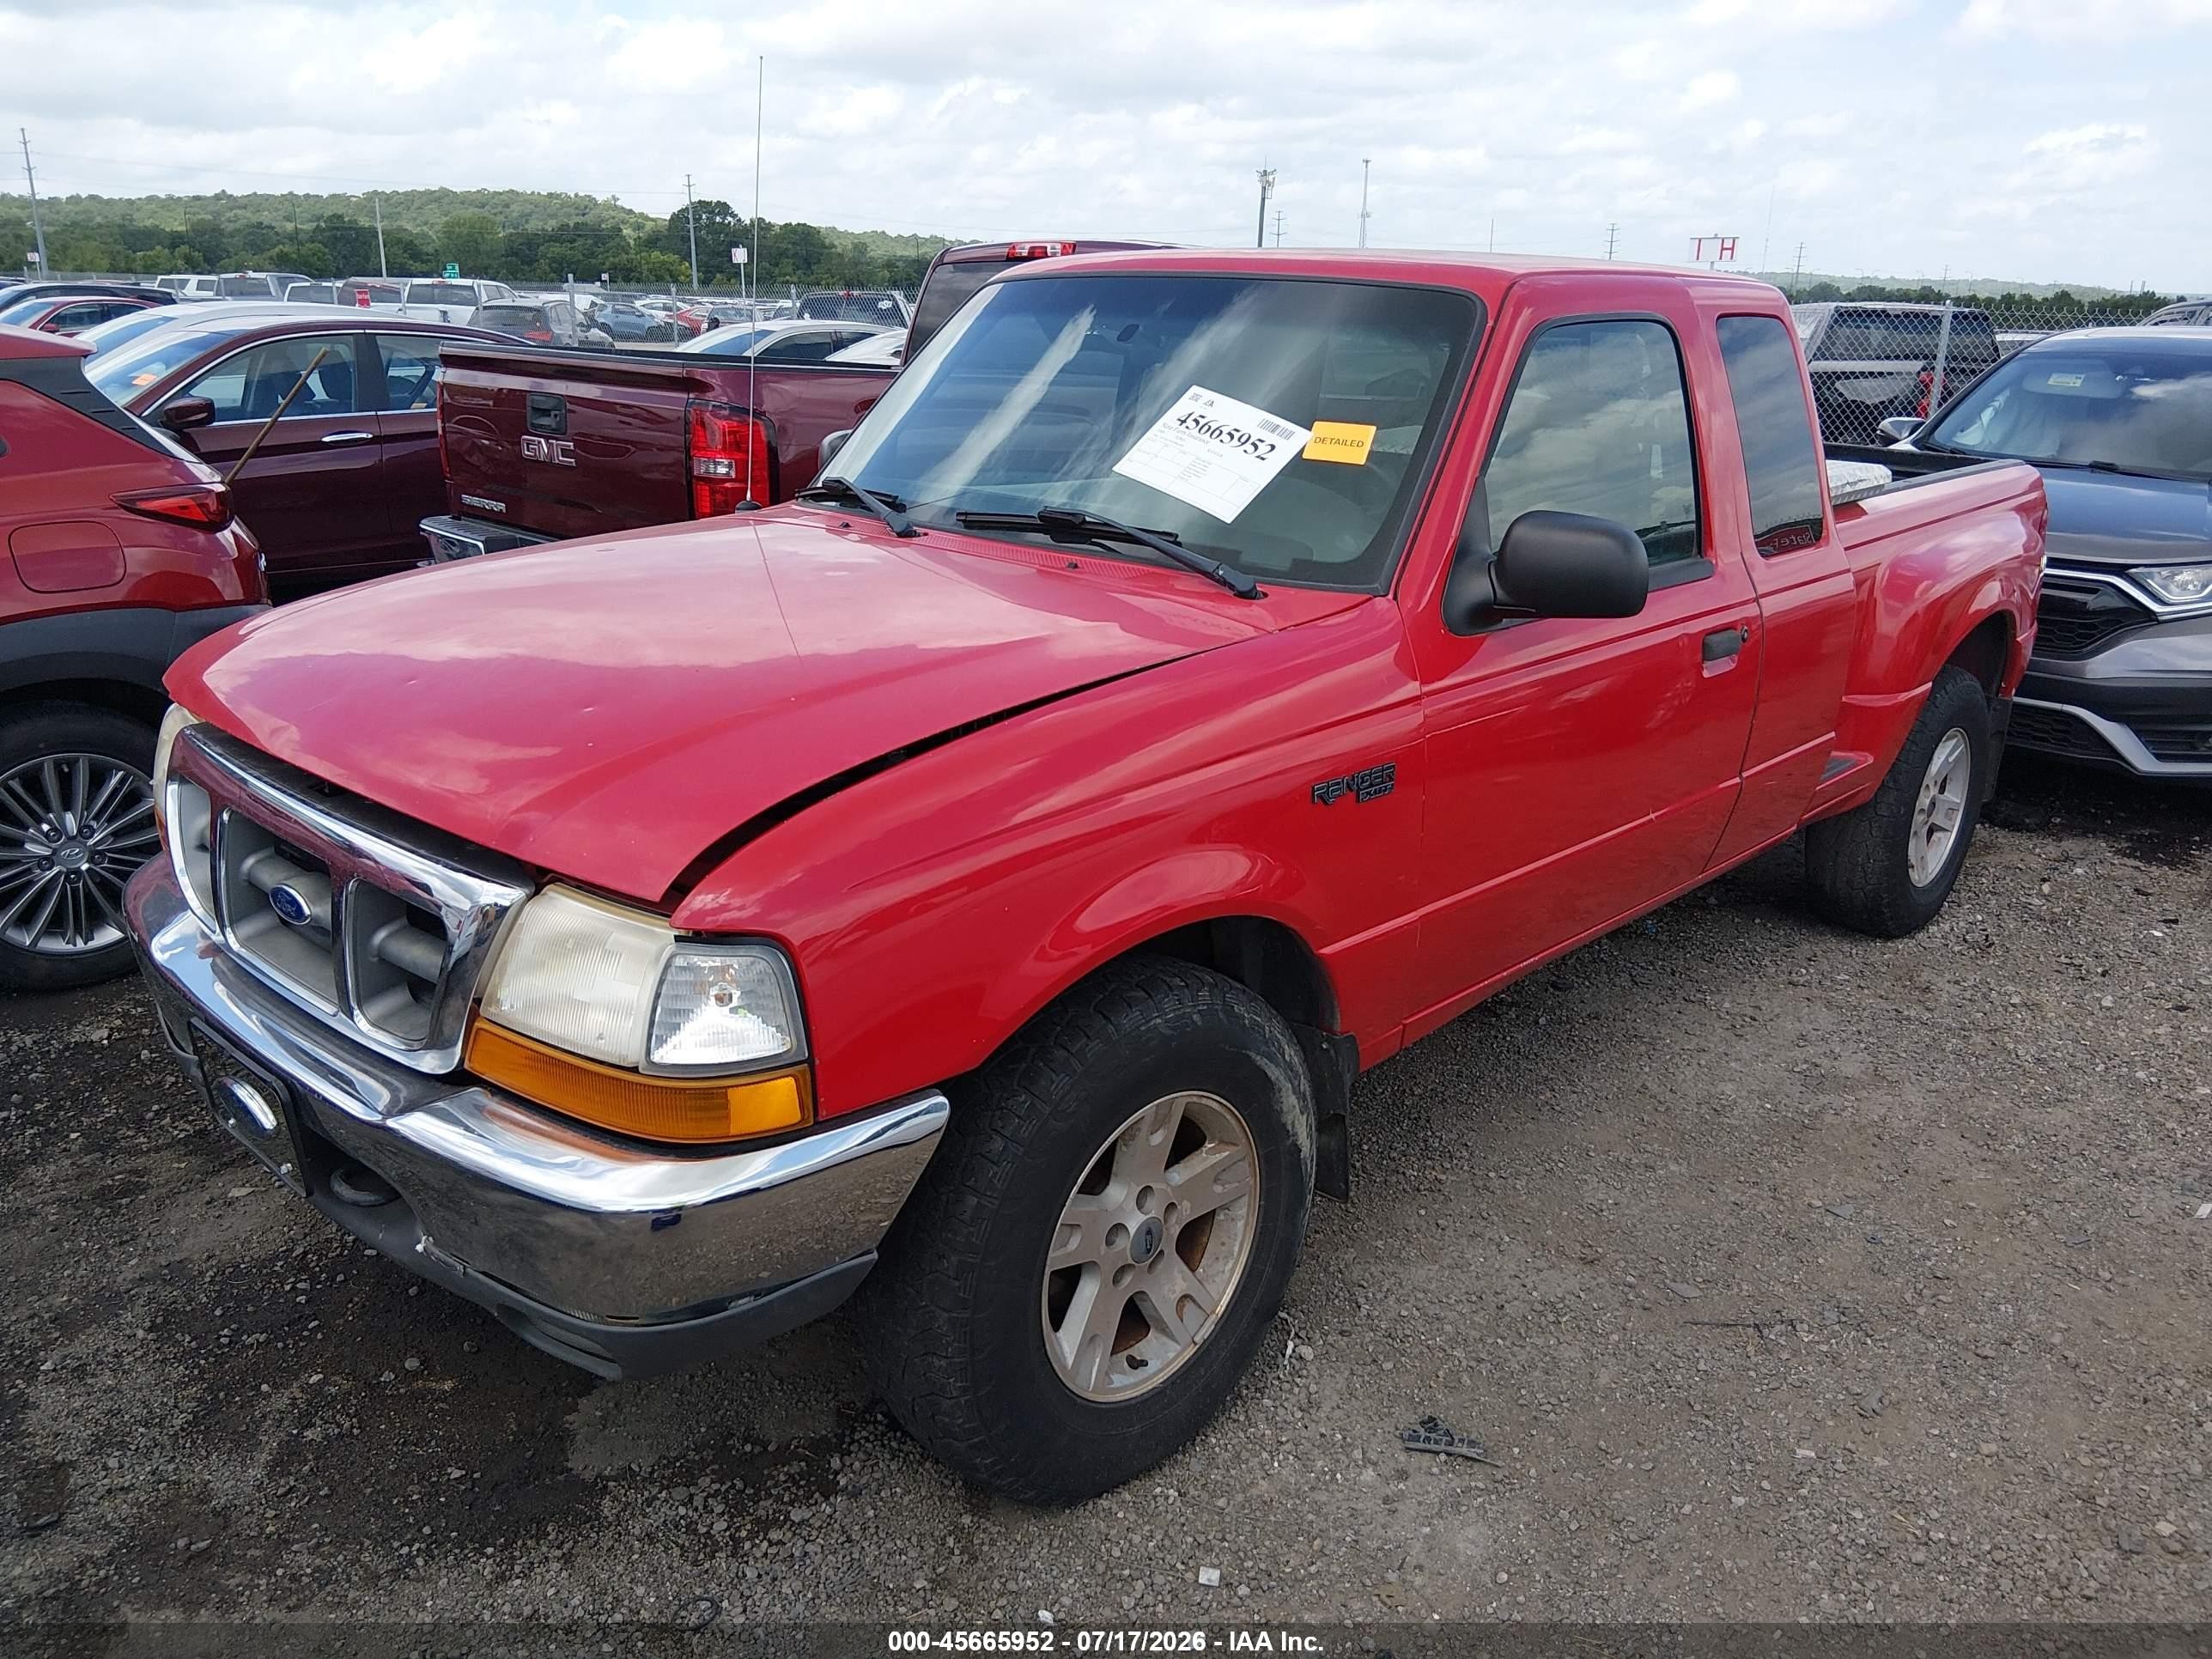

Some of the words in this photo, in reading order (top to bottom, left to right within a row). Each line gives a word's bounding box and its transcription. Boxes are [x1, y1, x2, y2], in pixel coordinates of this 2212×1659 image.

[1719, 238, 1735, 260] H
[1176, 411, 1277, 461] 45665952
[1314, 436, 1364, 448] DETAILED
[521, 435, 576, 466] GMC
[461, 494, 507, 514] SIERRA
[1312, 762, 1395, 805] RANGER
[275, 890, 298, 918] Ford
